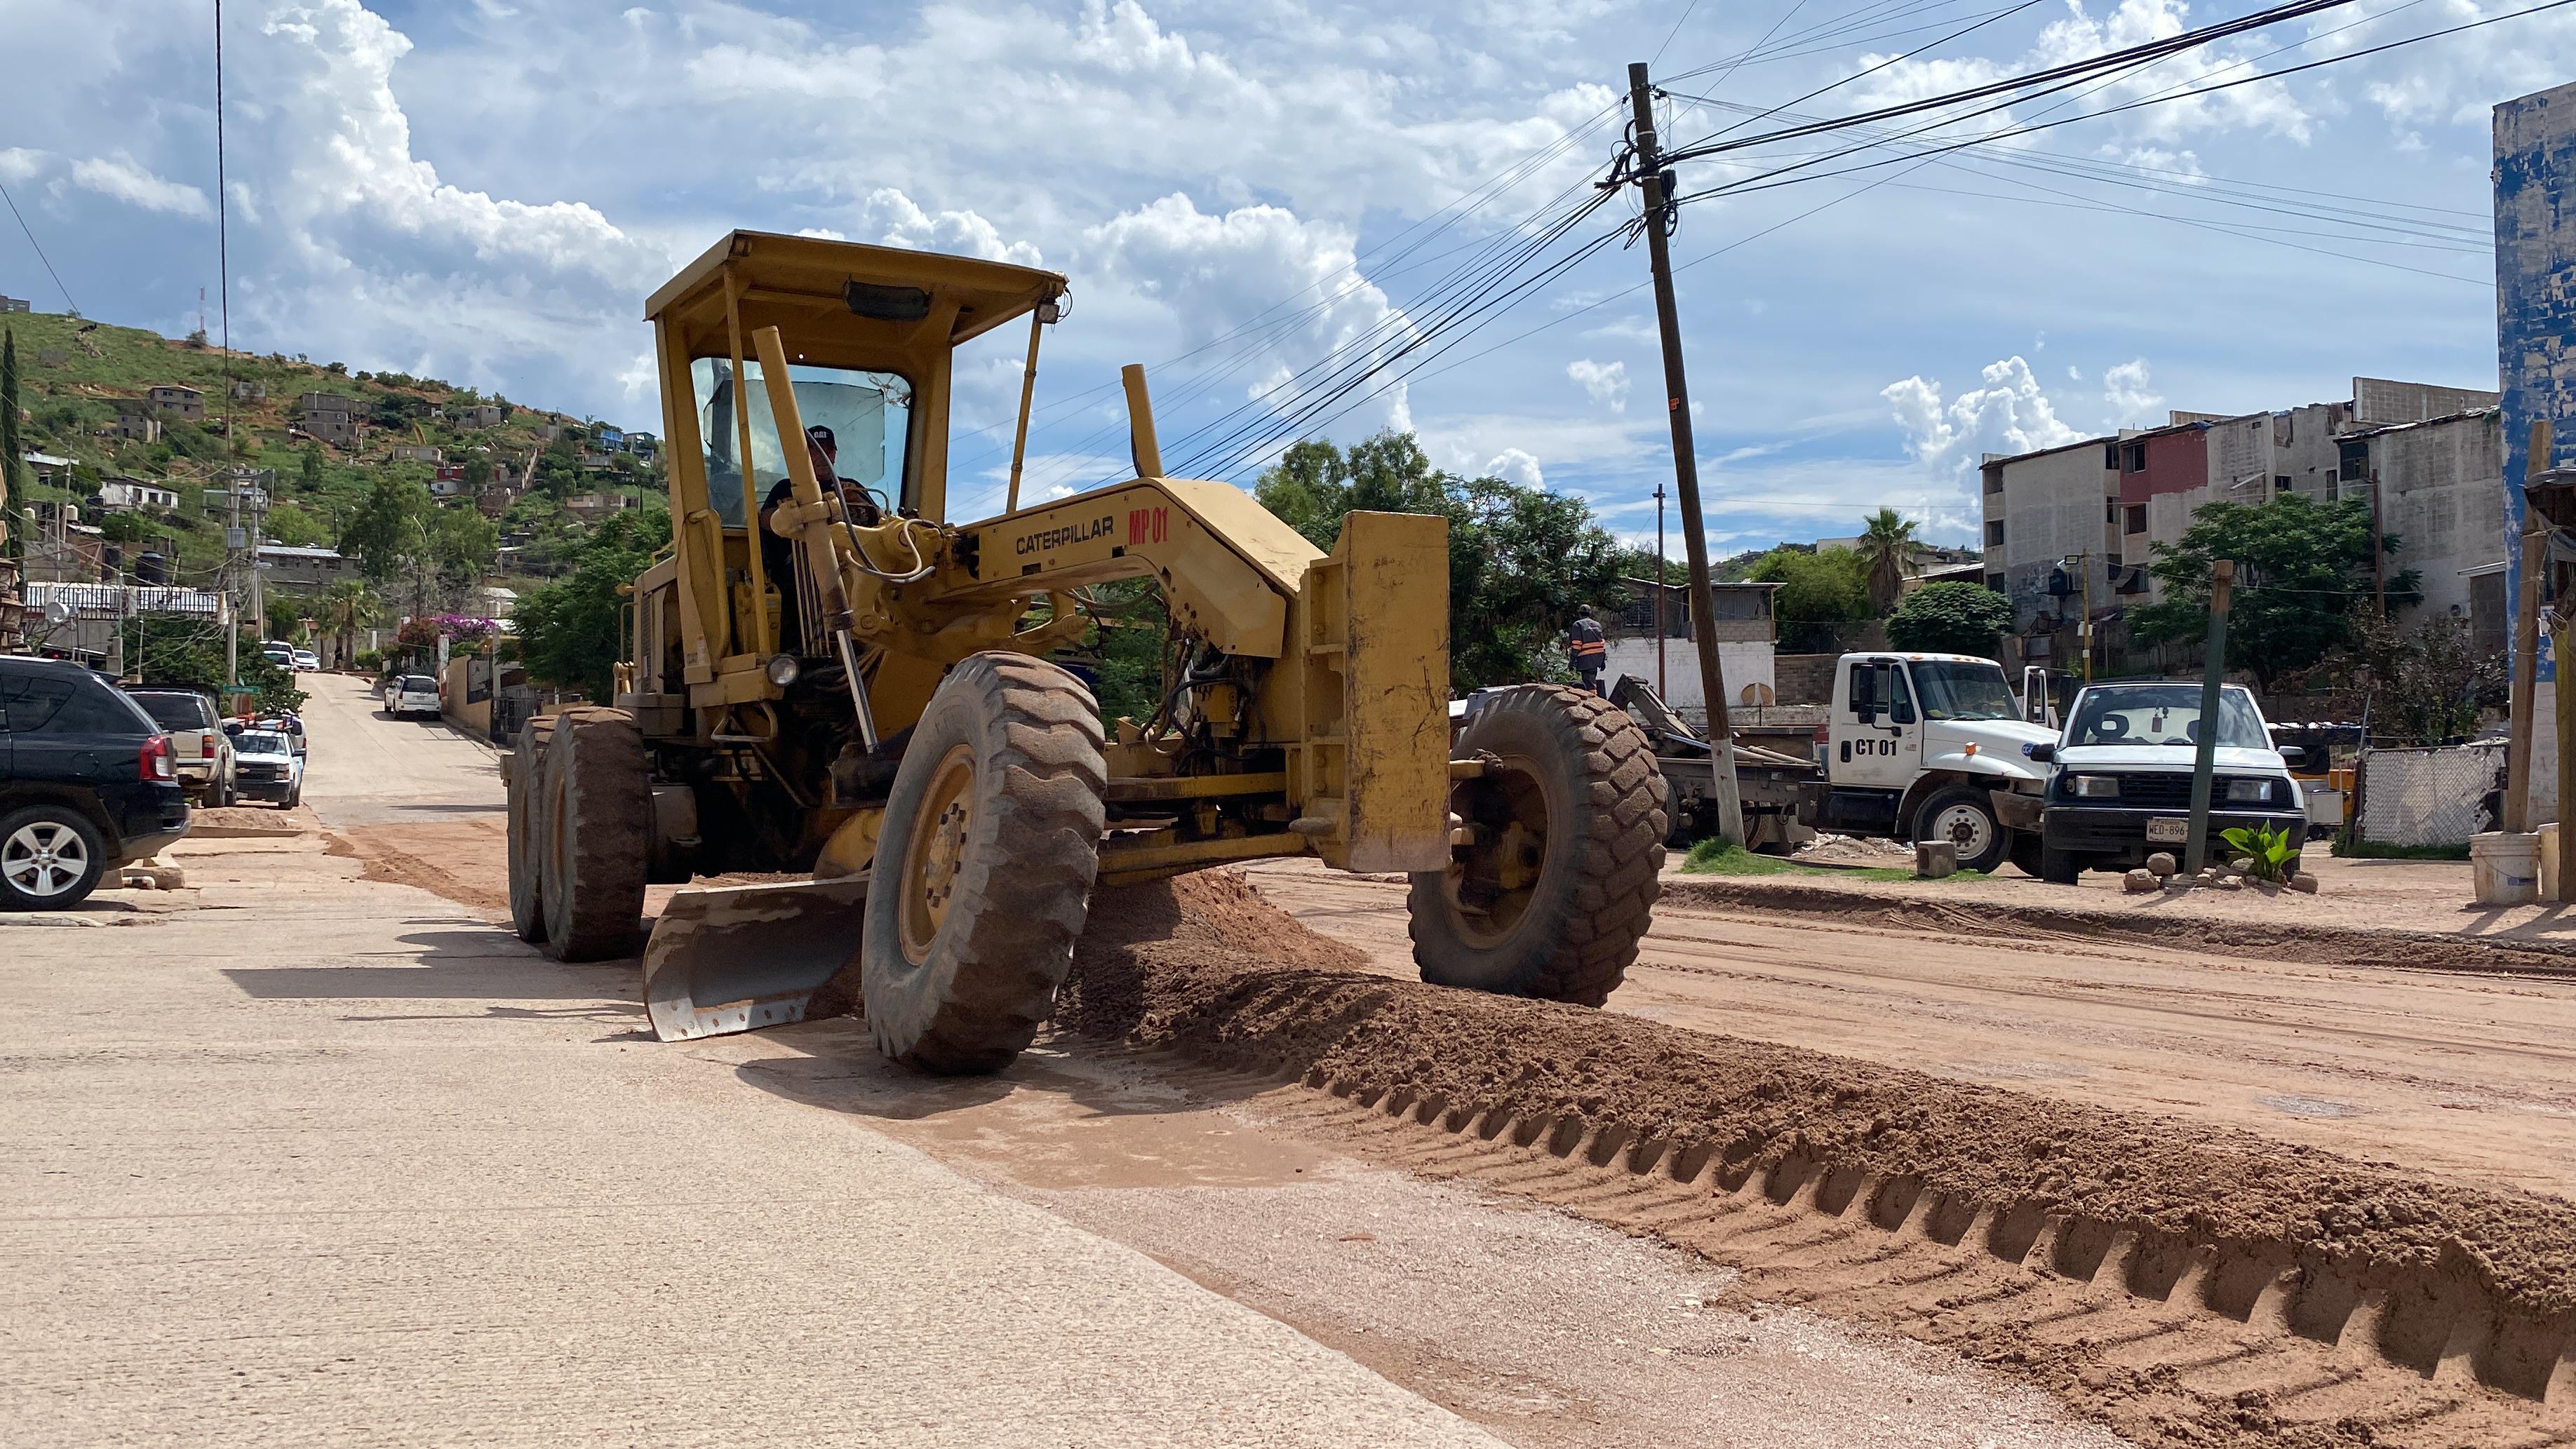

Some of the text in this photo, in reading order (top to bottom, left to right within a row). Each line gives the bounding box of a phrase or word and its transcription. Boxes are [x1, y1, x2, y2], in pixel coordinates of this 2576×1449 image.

[1017, 515, 1113, 555] CATERPILLAR
[1129, 506, 1168, 546] MP 01
[1856, 739, 1875, 755] CT
[1879, 739, 1897, 756] 01
[2149, 824, 2188, 835] WED-896-
